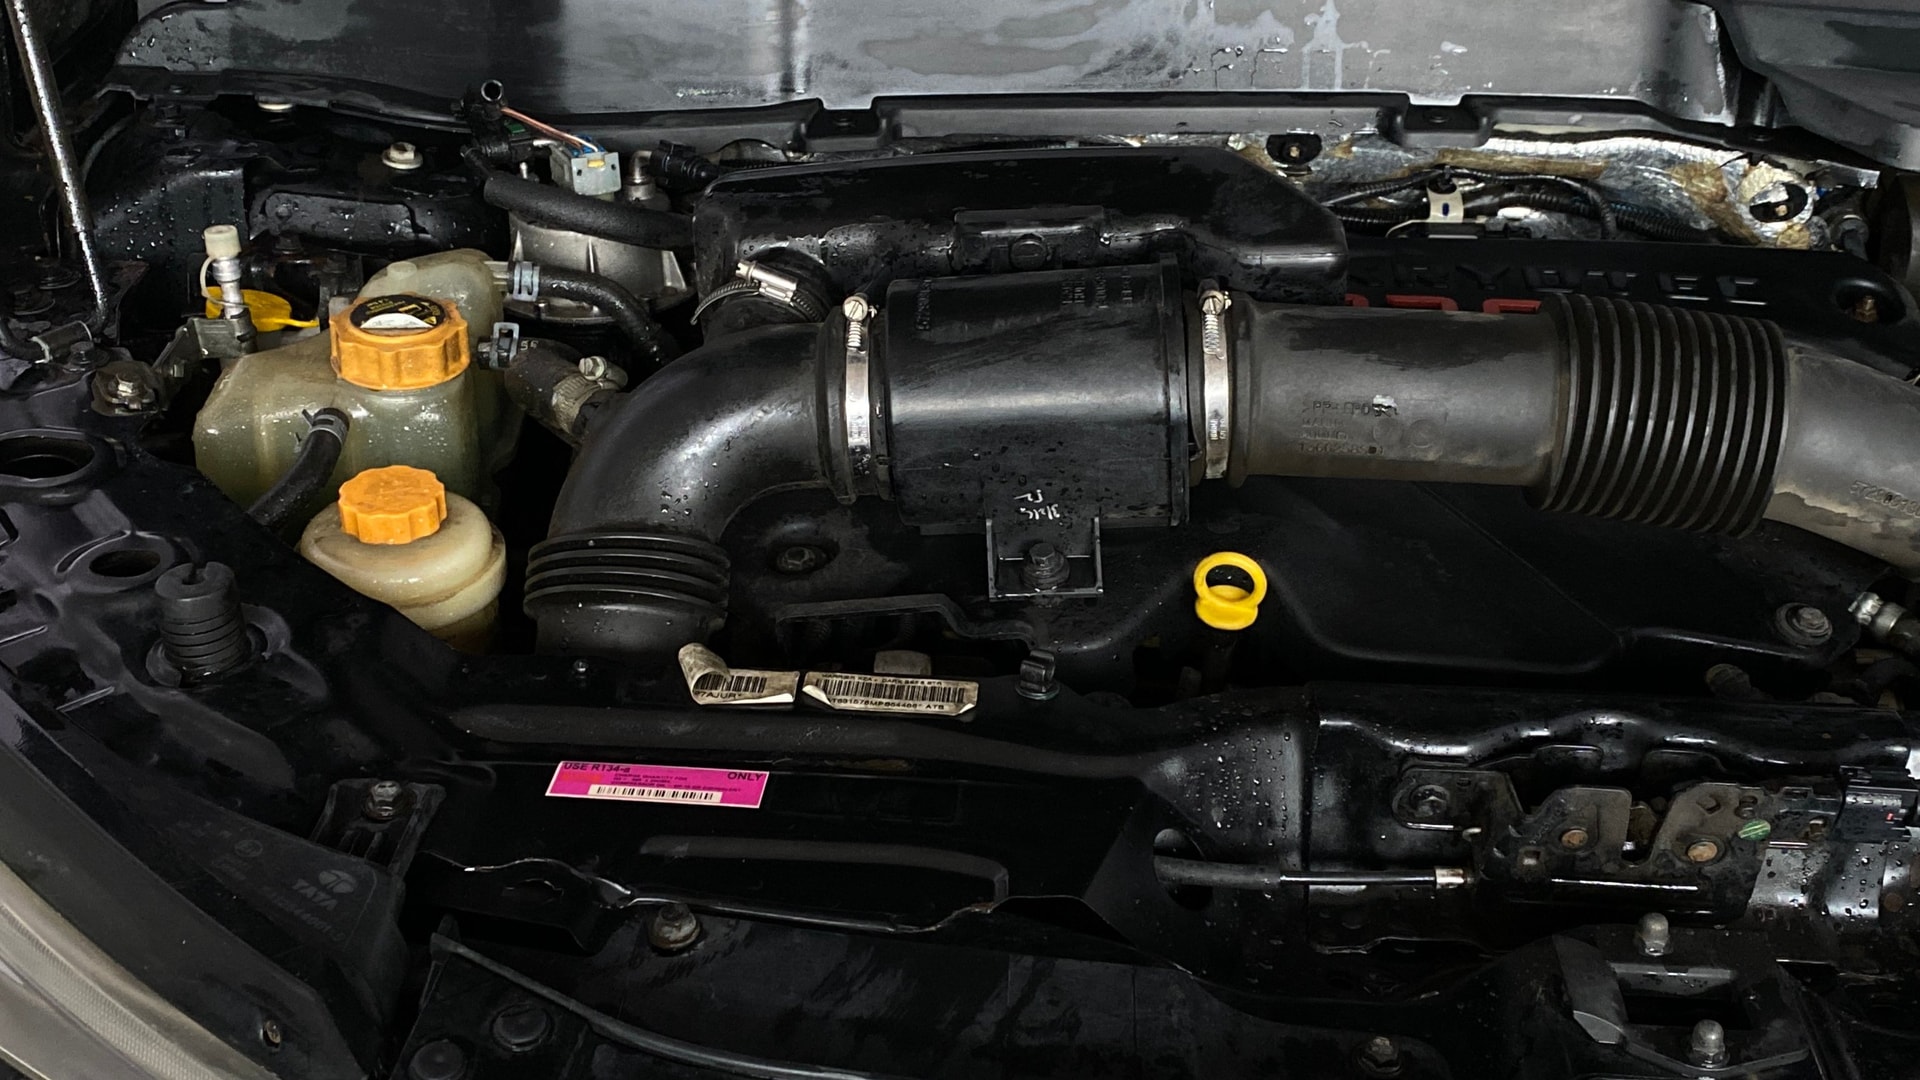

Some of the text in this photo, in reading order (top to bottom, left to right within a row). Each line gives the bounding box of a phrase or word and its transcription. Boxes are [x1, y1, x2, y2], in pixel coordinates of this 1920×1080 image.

[564, 762, 763, 781] USE R134-a ONLY
[291, 878, 338, 911] TATA
